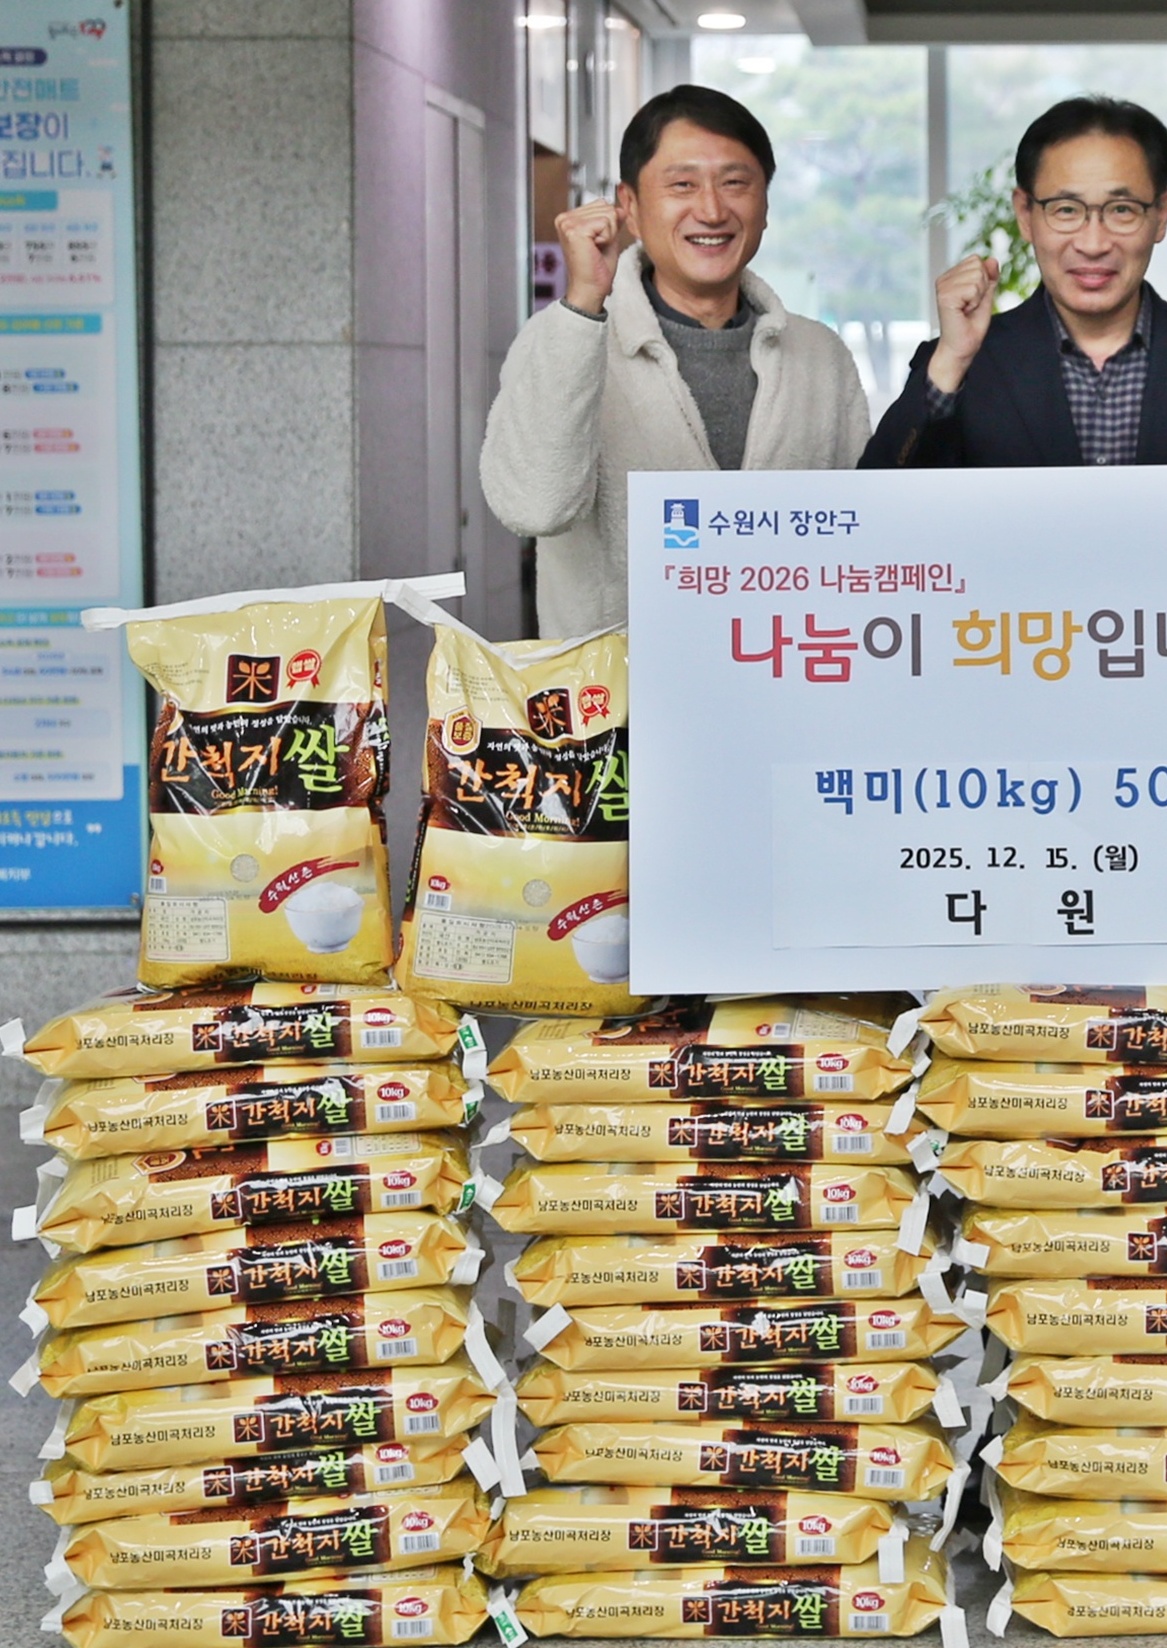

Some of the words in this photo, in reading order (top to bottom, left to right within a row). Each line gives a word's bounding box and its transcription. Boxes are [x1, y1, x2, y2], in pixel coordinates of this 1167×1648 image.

[707, 509, 780, 537] 수원시
[789, 509, 861, 537] 장안구
[664, 564, 732, 595] 『희망
[739, 565, 810, 592] 2026
[819, 563, 966, 594] 나눔캠페인』
[731, 612, 922, 684] 나눔이
[161, 724, 351, 793] 간척지쌀
[210, 788, 236, 800] Good
[814, 766, 1083, 815] 백미(10kg)
[899, 847, 972, 871] 2025.
[986, 846, 1026, 871] 12.
[1044, 847, 1078, 871] 15.
[1092, 843, 1140, 873] (월)
[944, 889, 988, 937] 다
[1056, 889, 1096, 937] 원
[365, 1011, 391, 1024] 10kg
[968, 1022, 1070, 1040] 남포농산미곡처리장
[819, 1057, 844, 1069] 10kg
[530, 1068, 631, 1081] 남포농산미곡처리장
[686, 1056, 791, 1091] 간척지쌀
[379, 1085, 404, 1098] 10kg
[241, 1091, 352, 1124] 간척지쌀
[555, 1123, 651, 1137] 남포농산미곡처리장
[385, 1174, 410, 1187] 10kg
[249, 1175, 357, 1210] 간척지쌀
[826, 1187, 850, 1199] 10kg
[538, 1199, 638, 1212] 남포농산미곡처리장
[690, 1189, 796, 1221] 간척지쌀
[380, 1243, 406, 1255] 10kg
[243, 1249, 354, 1287] 간척지쌀
[716, 1254, 819, 1290] 간척지쌀
[85, 1279, 189, 1303] 남포농산미곡처리장
[381, 1323, 405, 1335] 10kg
[871, 1314, 896, 1327] 10kg
[1027, 1313, 1128, 1326] 남포농산미곡처리장
[241, 1325, 352, 1362] 간척지쌀
[408, 1397, 433, 1409] 10kg
[270, 1401, 380, 1438] 간척지쌀
[111, 1425, 216, 1446] 남포농산미곡처리장
[379, 1448, 405, 1460] 10kg
[740, 1445, 844, 1482] 간척지쌀
[872, 1450, 896, 1462] 10kg
[244, 1451, 347, 1491] 간척지쌀
[404, 1516, 428, 1528] 10kg
[801, 1520, 826, 1532] 10kg
[267, 1522, 377, 1558] 간척지쌀
[509, 1529, 611, 1542] 남포농산미곡처리장
[664, 1516, 771, 1554] 간척지쌀
[110, 1547, 211, 1564] 남포농산미곡처리장
[397, 1602, 422, 1614] 10kg
[718, 1593, 827, 1629] 간척지쌀
[855, 1597, 879, 1608] 10kg
[258, 1603, 366, 1638] 간척지쌀
